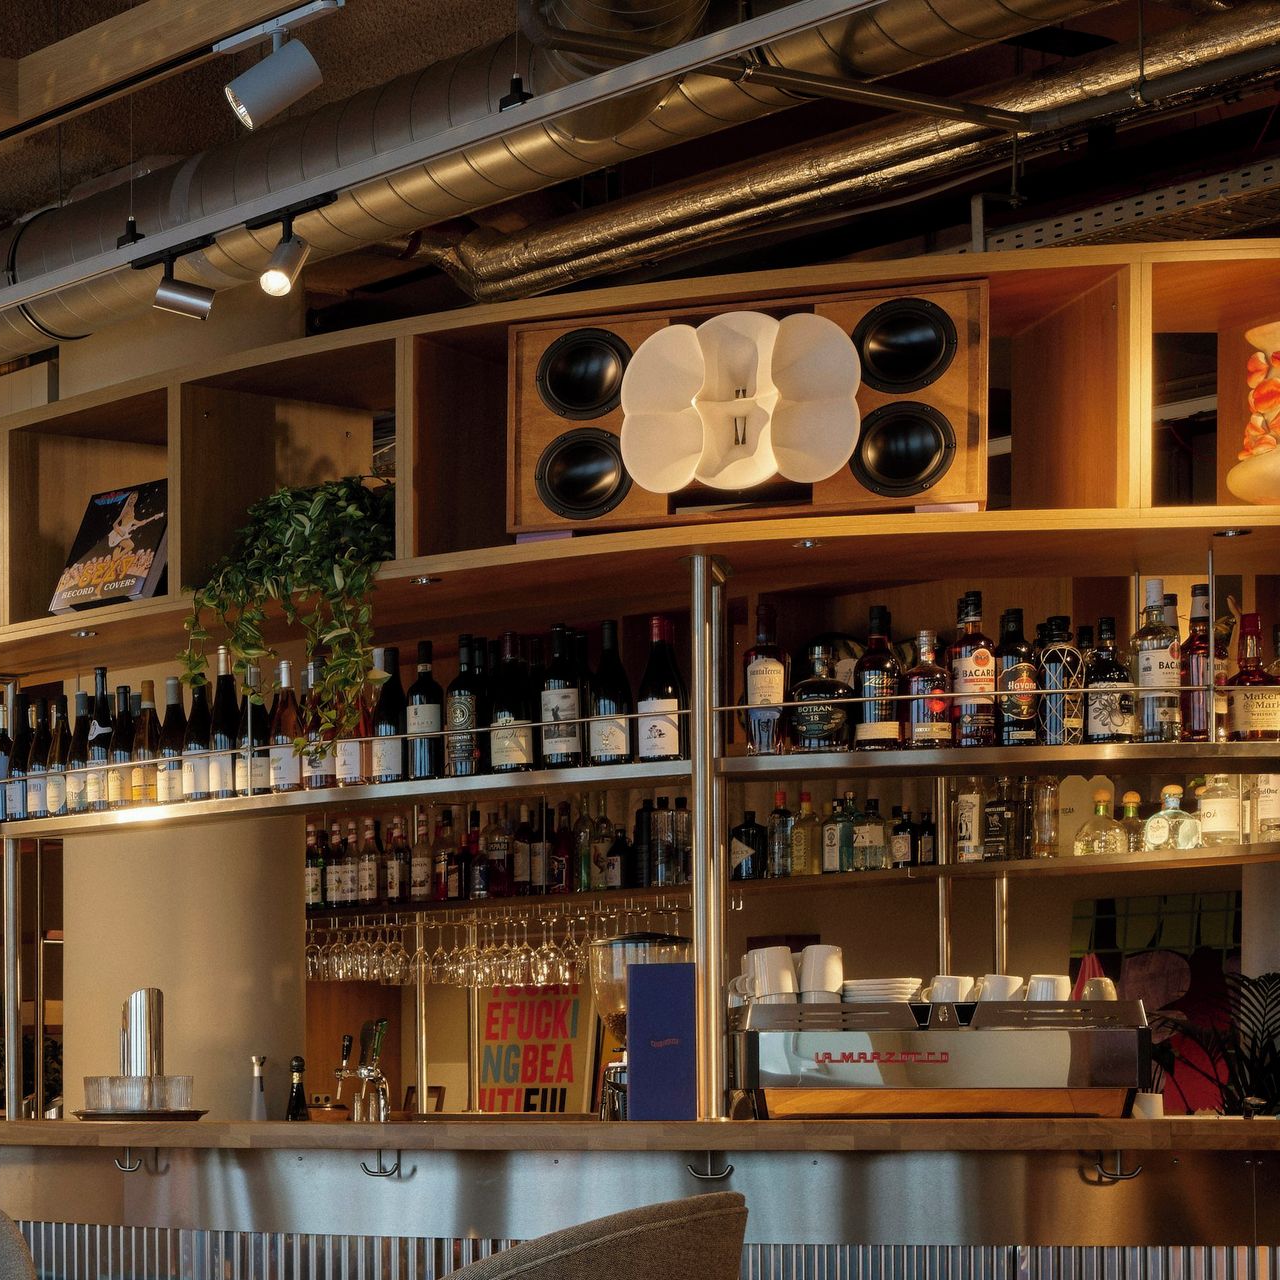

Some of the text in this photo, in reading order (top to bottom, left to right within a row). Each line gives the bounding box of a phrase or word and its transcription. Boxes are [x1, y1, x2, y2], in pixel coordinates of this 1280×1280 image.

[61, 578, 137, 599] RECORD COVERS
[1007, 680, 1036, 690] Havana
[798, 704, 832, 713] BOTRAN
[1021, 705, 1028, 715] 7
[810, 714, 819, 722] 18
[484, 998, 580, 1042] EFUCKI
[481, 1043, 575, 1085] NGBEA
